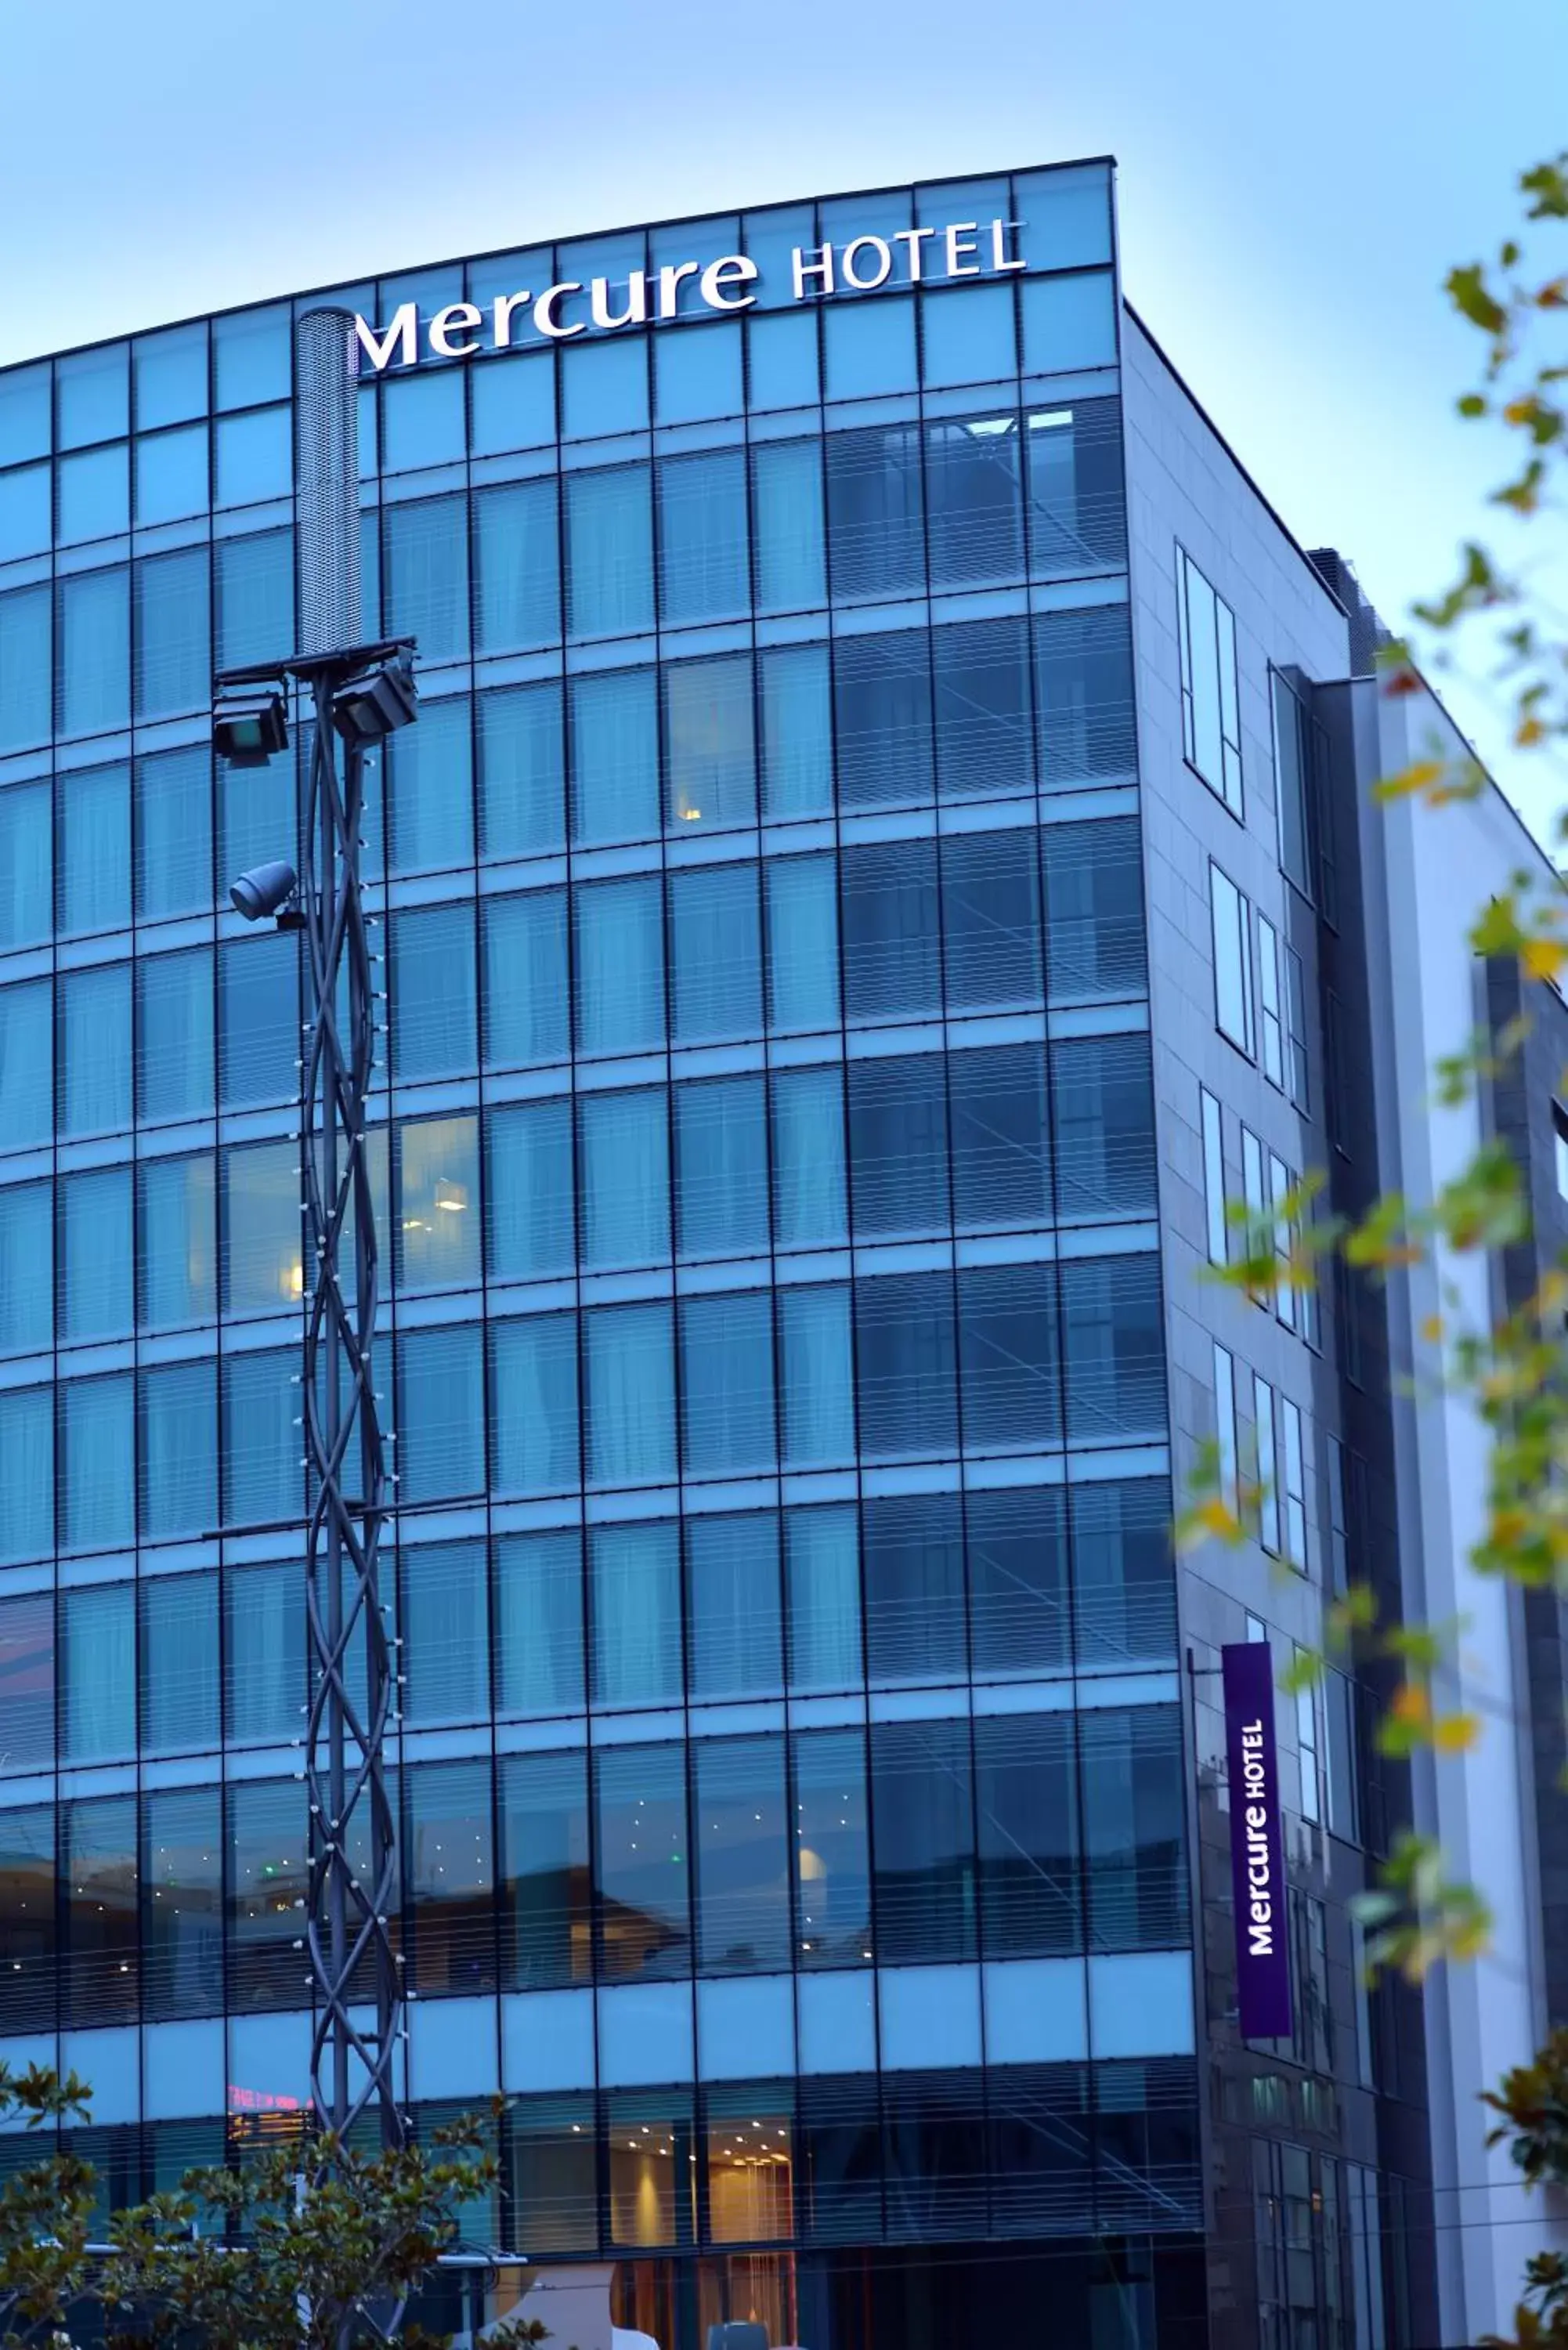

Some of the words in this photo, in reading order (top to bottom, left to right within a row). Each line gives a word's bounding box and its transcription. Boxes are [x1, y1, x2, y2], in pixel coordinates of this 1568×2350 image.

[349, 254, 758, 371] Mercure
[792, 219, 1027, 299] HOTEL
[1242, 1719, 1265, 1799] HOTEL
[1246, 1806, 1274, 1955] Mercure
